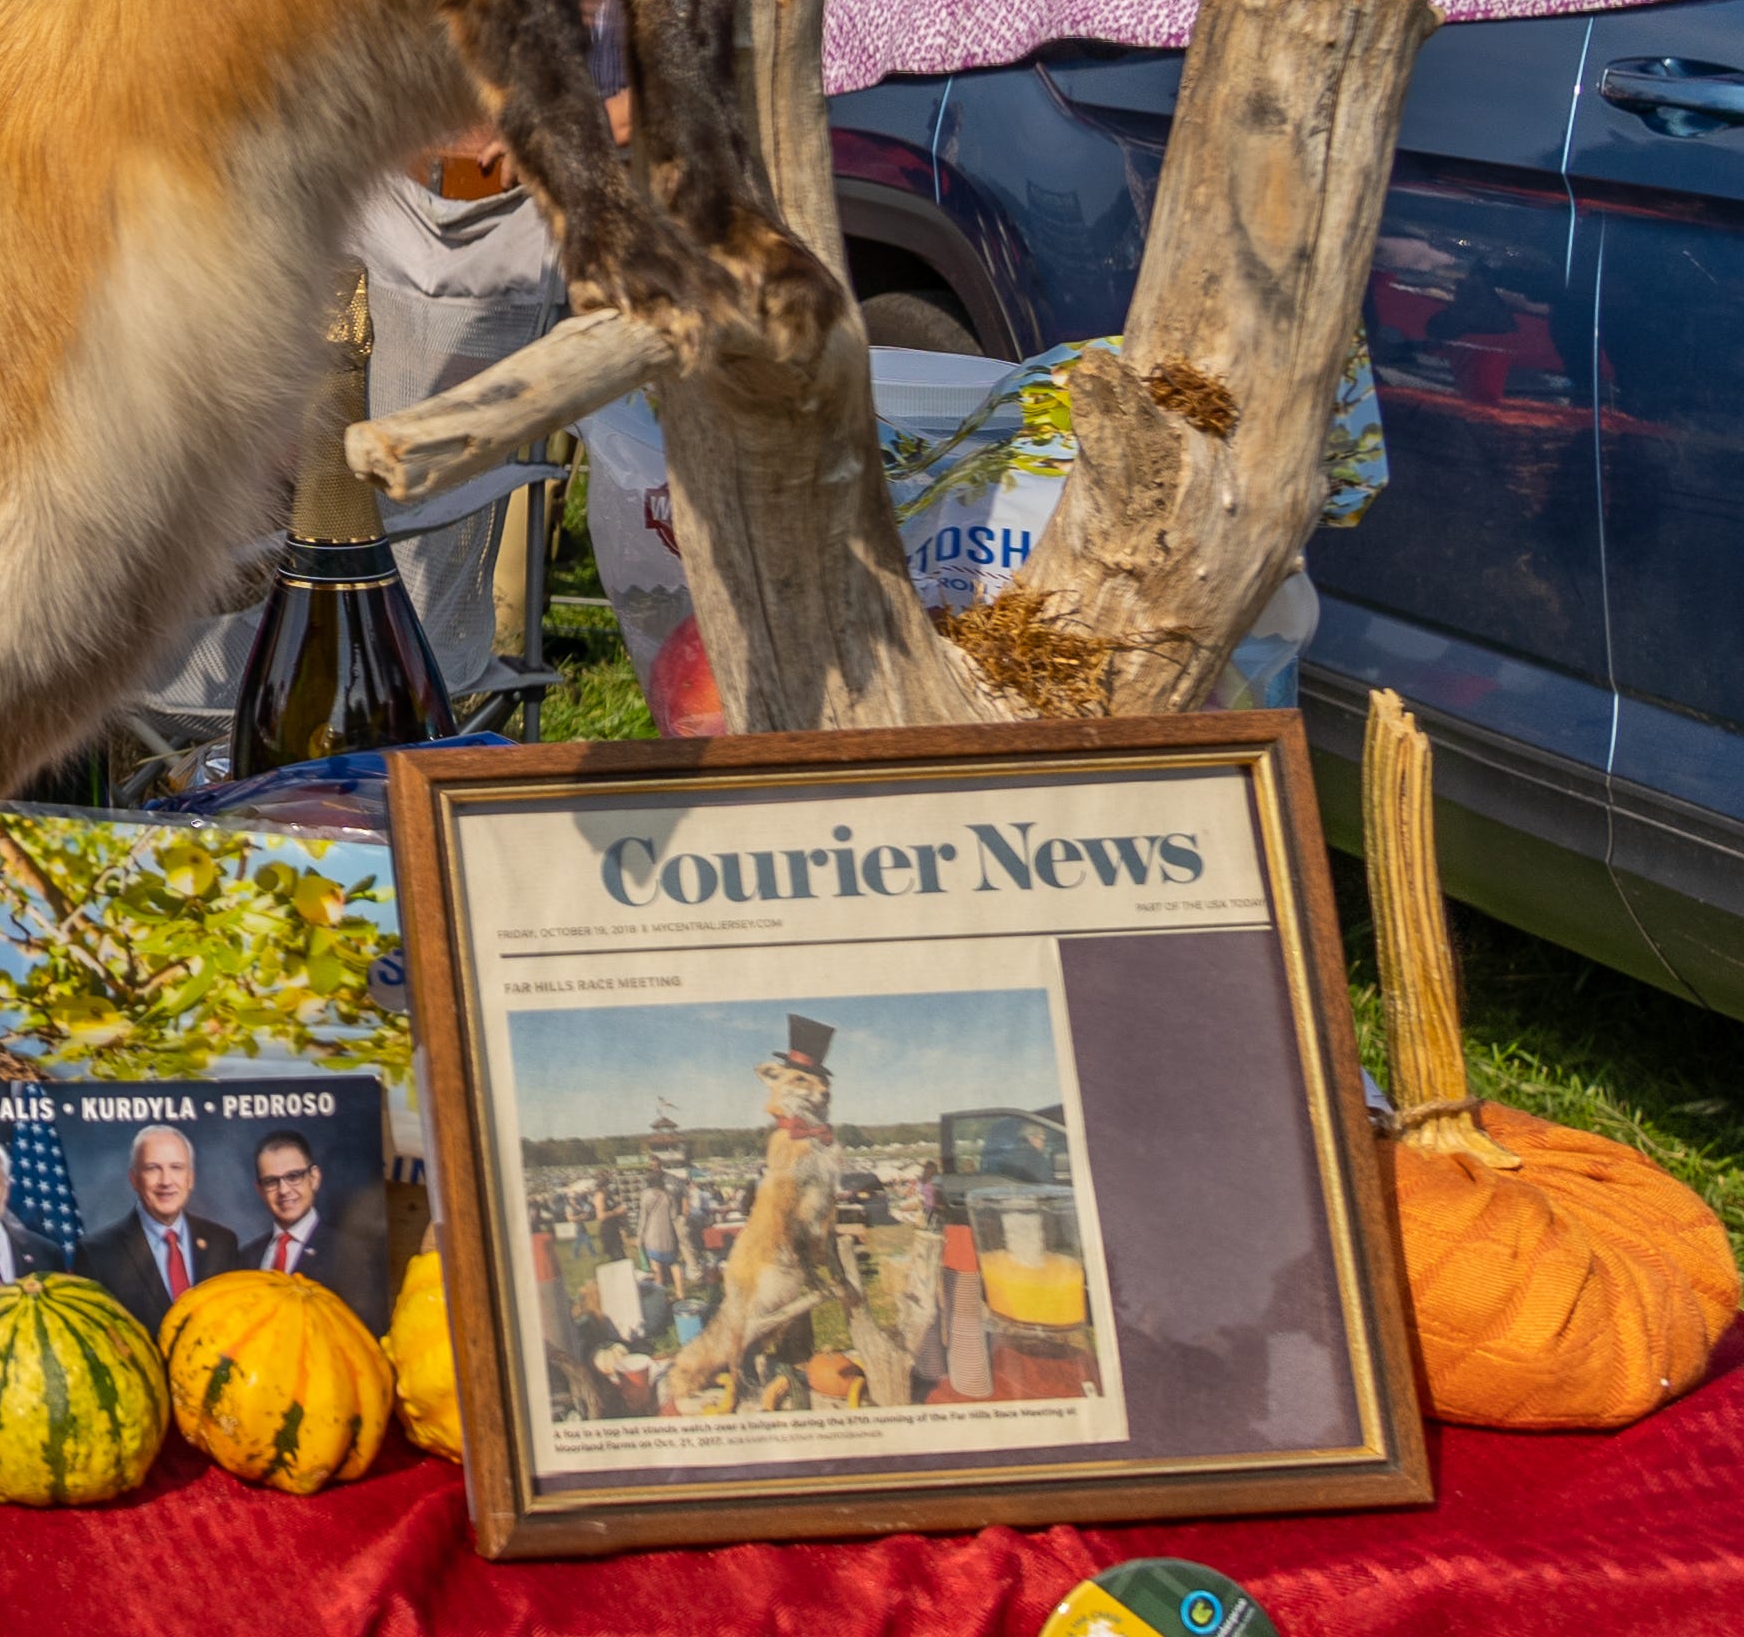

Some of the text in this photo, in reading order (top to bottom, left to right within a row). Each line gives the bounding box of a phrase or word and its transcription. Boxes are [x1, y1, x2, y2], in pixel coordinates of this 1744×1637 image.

[601, 822, 1204, 907] Courier News
[1135, 902, 1162, 913] PART
[1165, 901, 1179, 912] OF
[1182, 900, 1203, 911] THE
[497, 928, 539, 940] FRIDAY,
[540, 926, 592, 938] OCTOBER
[611, 925, 637, 935] 2018
[652, 919, 783, 933] MYCENTRALJERSEY.COM
[504, 975, 682, 995] FAR HILLS RACE MEETING
[81, 1095, 198, 1121] KURDYLA
[222, 1092, 335, 1119] PEDROSO
